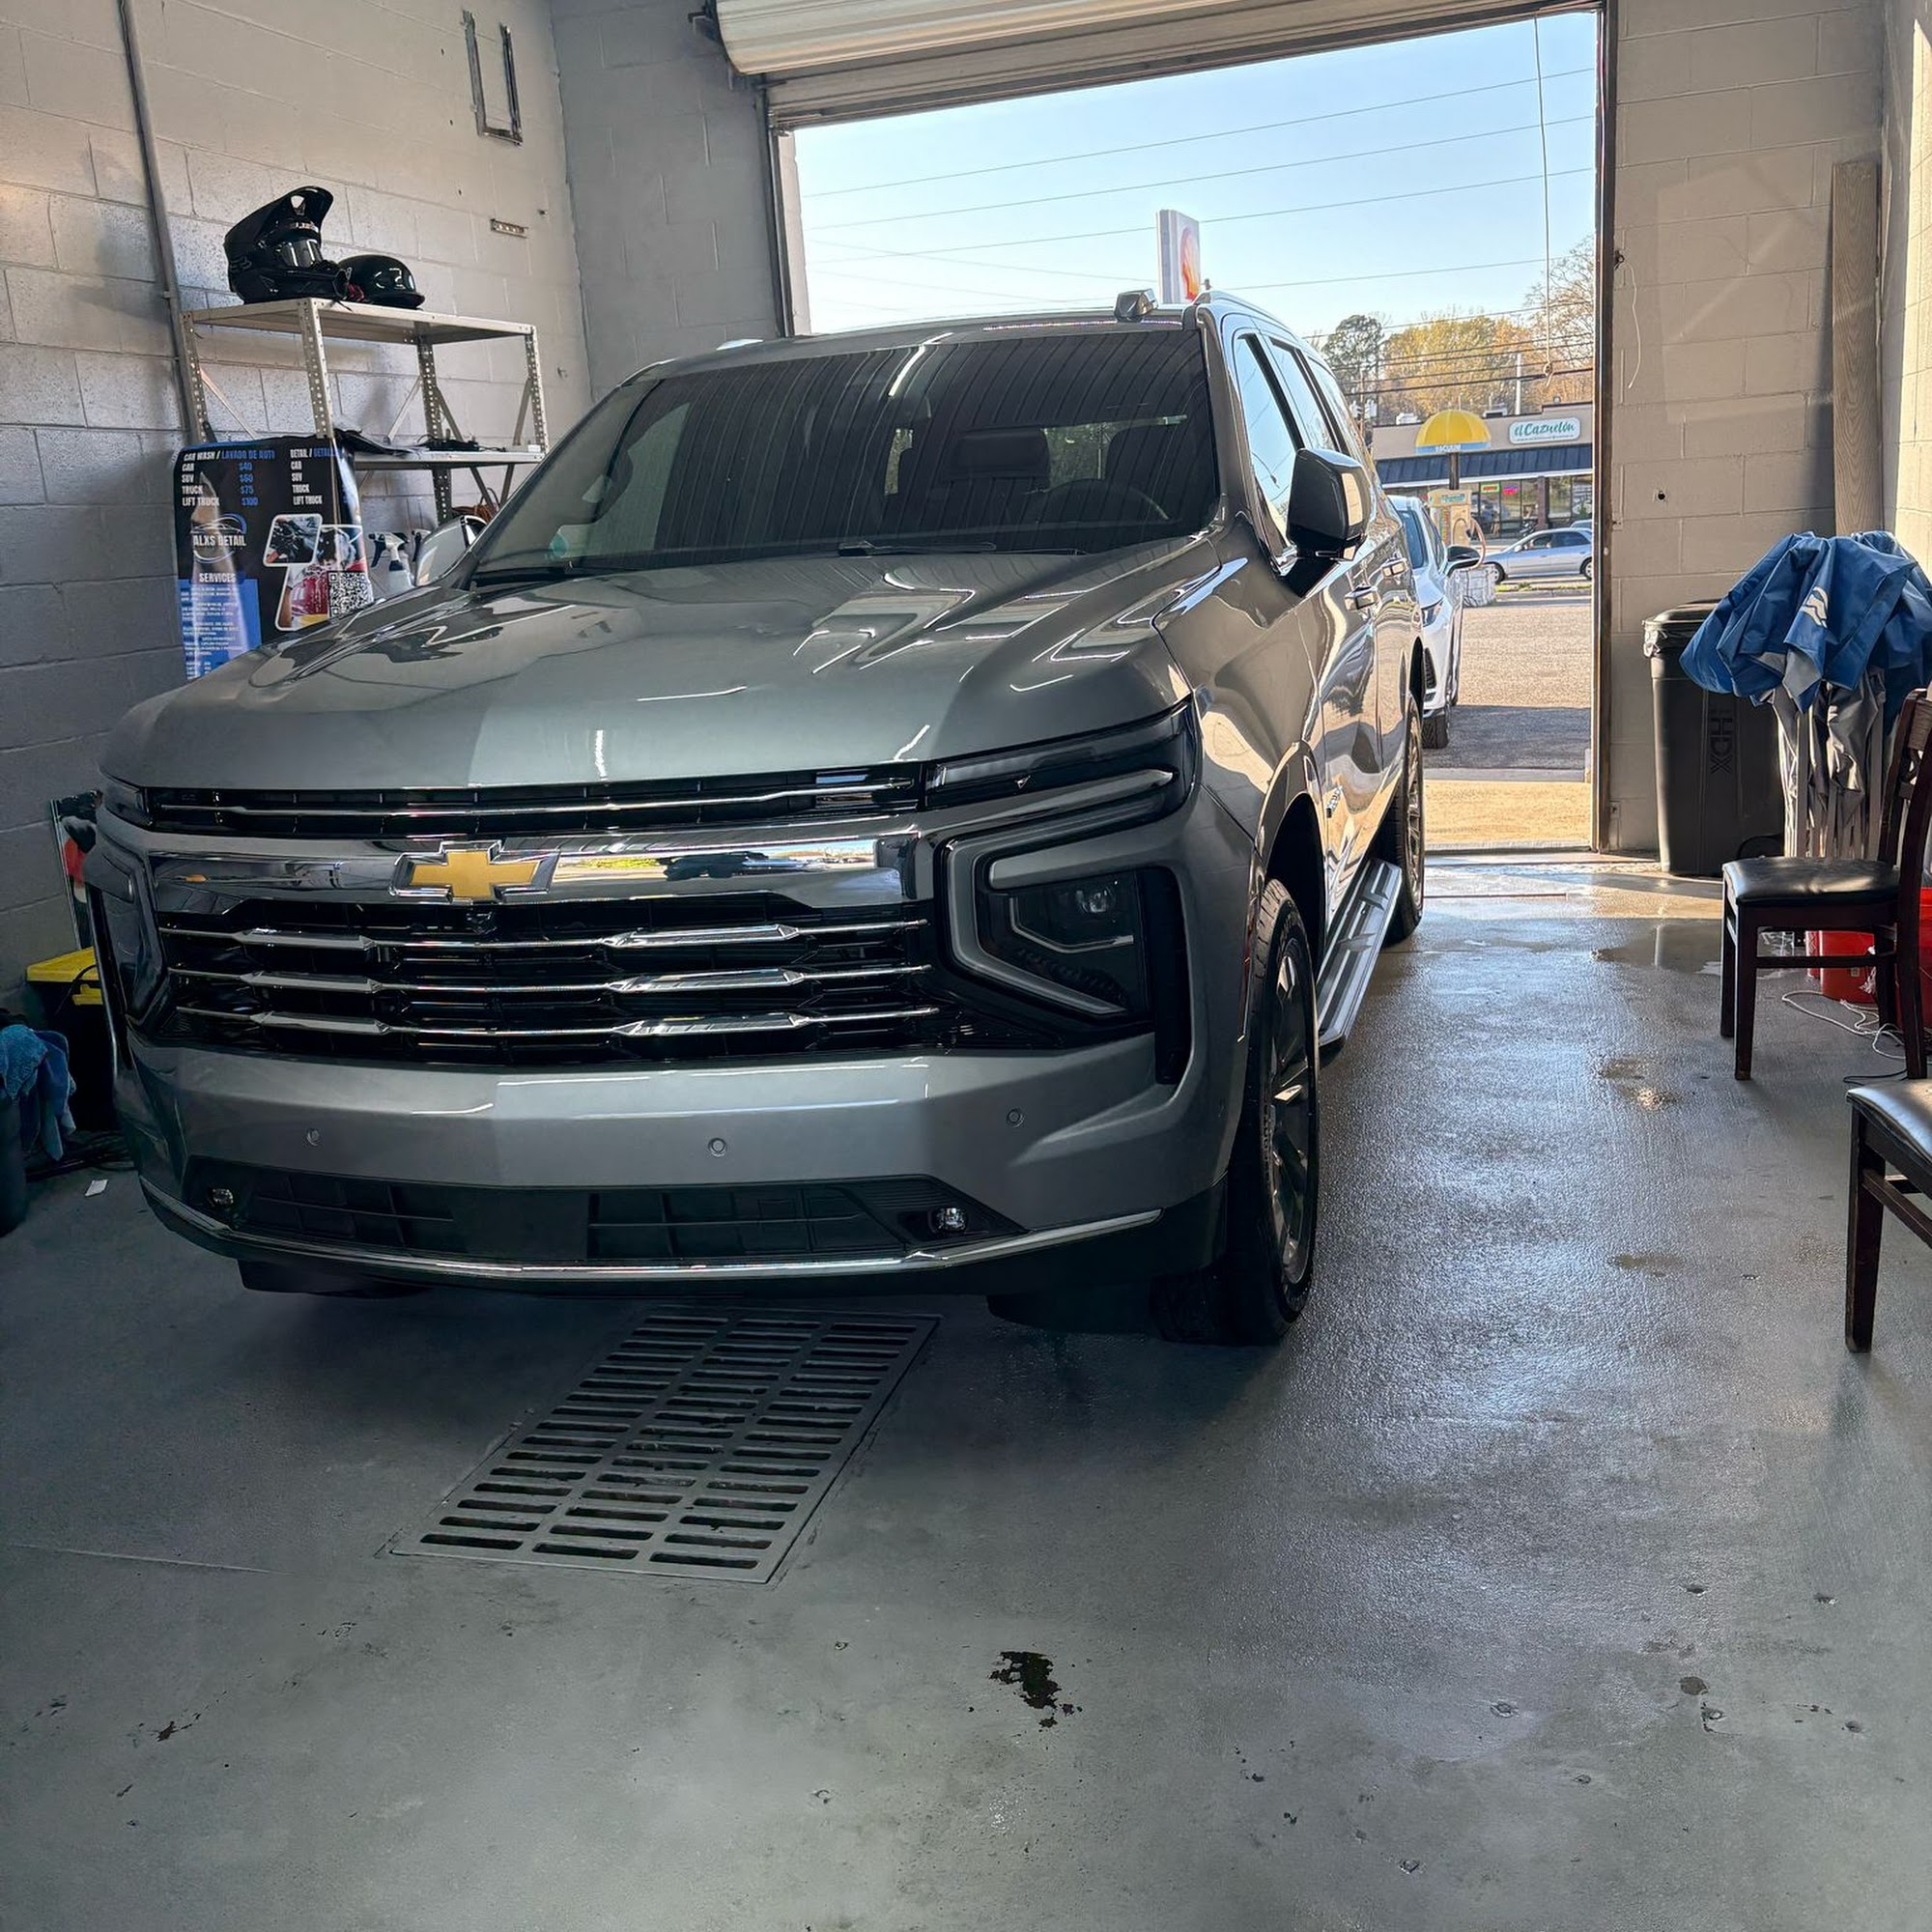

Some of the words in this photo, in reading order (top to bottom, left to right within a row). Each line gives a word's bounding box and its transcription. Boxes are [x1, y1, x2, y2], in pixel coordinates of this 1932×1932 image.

[184, 452, 196, 461] CAR
[196, 450, 215, 460] WASH
[182, 463, 194, 471] CAR
[290, 460, 302, 470] CAR
[182, 473, 194, 483] SUV
[291, 472, 302, 482] SUV
[182, 485, 204, 495] TRUCK
[292, 484, 309, 494] TRUCK
[182, 497, 196, 506] LIFT
[196, 497, 220, 506] TRUCK
[293, 496, 304, 505] LIFT
[304, 495, 323, 505] TRUCK
[193, 534, 216, 547] ALXS
[217, 534, 247, 547] DETAIL
[199, 572, 237, 583] SERVICES
[1709, 717, 1733, 775] HDX
